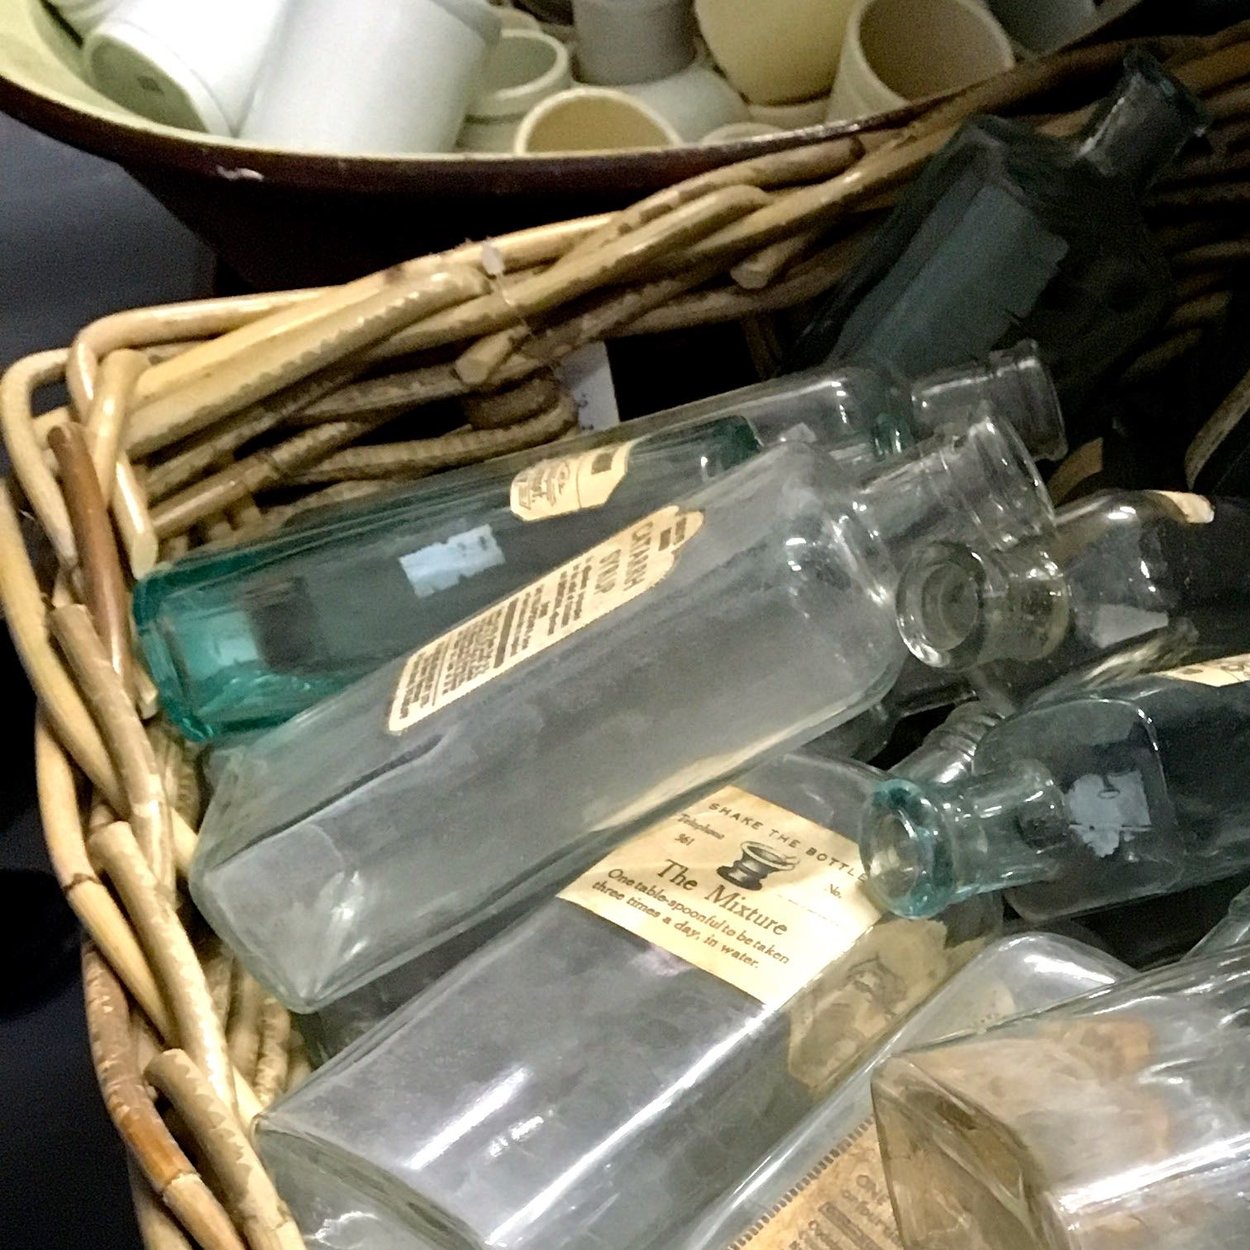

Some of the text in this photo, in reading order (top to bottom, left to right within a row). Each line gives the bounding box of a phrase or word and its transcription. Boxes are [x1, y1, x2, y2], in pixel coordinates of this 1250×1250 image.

[709, 802, 868, 882] SHAKE THE BOTTLE
[592, 880, 625, 900] three
[626, 897, 661, 918] times
[703, 934, 717, 948] in
[720, 945, 760, 968] water.
[657, 859, 788, 936] The Mixture
